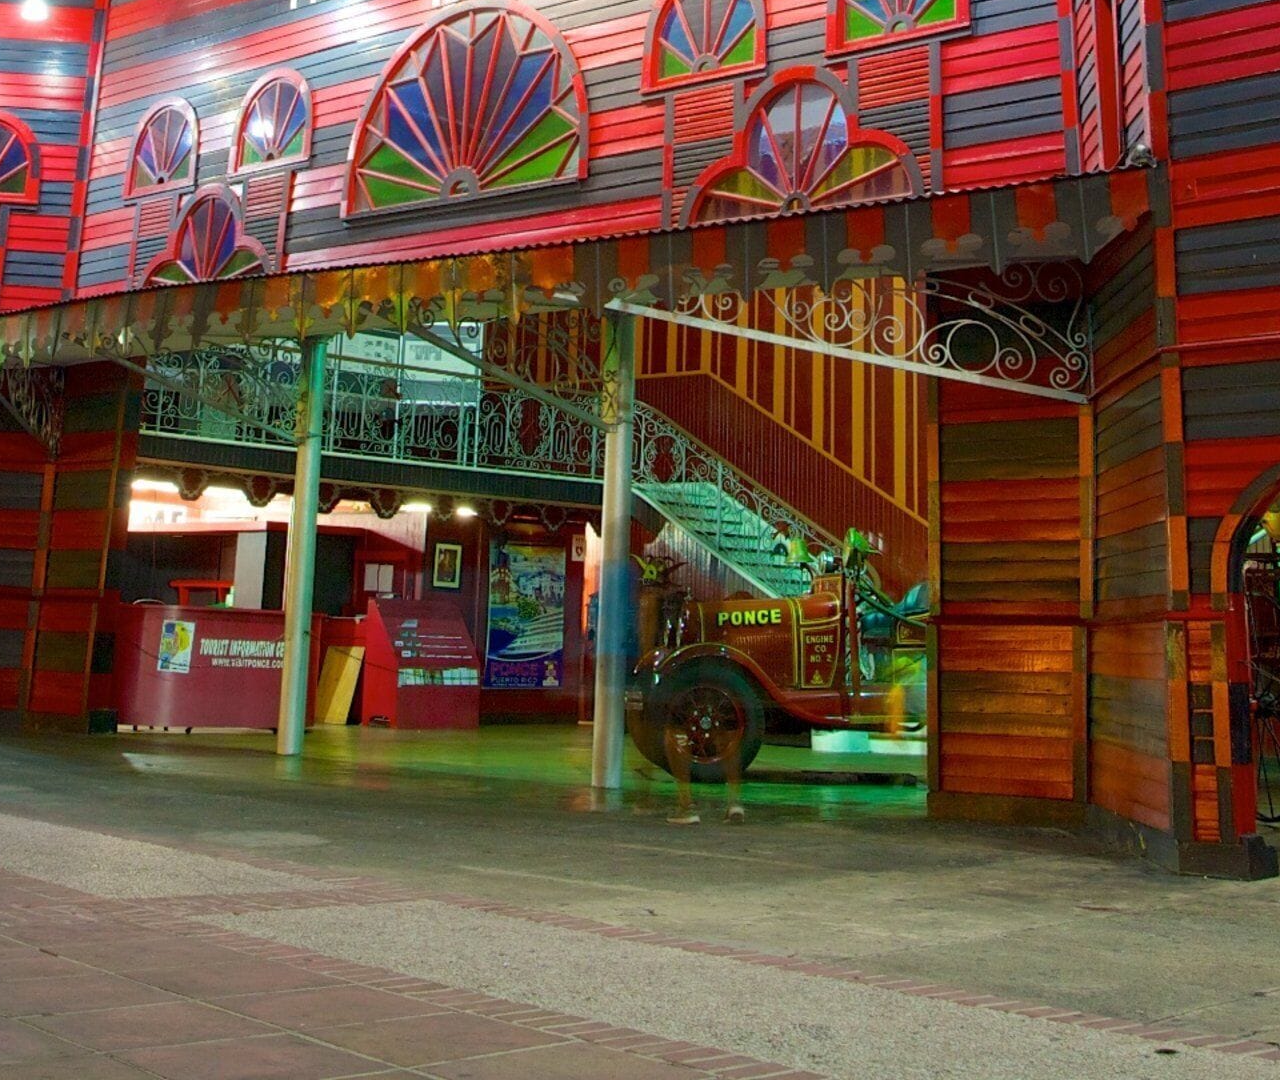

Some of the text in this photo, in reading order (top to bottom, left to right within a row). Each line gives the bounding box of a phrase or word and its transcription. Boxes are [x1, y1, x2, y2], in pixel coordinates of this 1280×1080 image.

[717, 608, 782, 626] PONCE
[805, 634, 834, 644] ENGINE
[200, 638, 229, 656] TOURIST
[229, 639, 275, 658] INFORMATION
[826, 654, 833, 663] 2
[490, 661, 538, 677] PONCE
